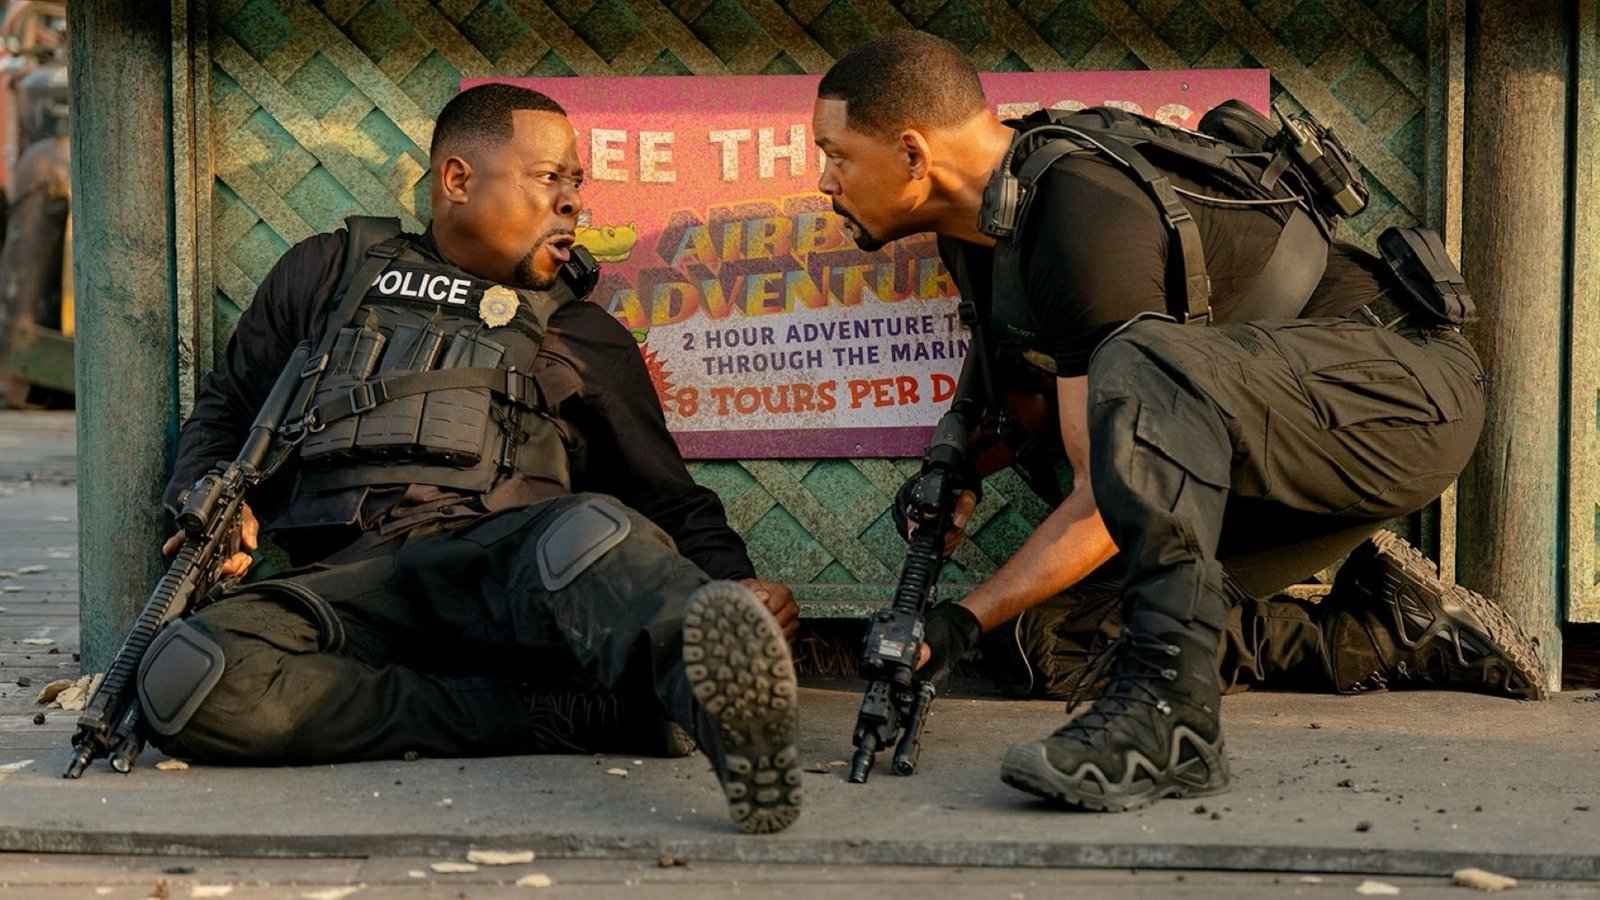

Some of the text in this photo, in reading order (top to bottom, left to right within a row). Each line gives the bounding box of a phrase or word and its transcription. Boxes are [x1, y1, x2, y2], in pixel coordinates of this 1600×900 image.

[573, 124, 827, 183] EE TH
[660, 196, 848, 267] AIRB
[371, 270, 471, 305] OLICE
[602, 258, 962, 329] ADVENTUR
[682, 332, 695, 351] 2
[705, 325, 774, 350] HOUR
[785, 314, 934, 344] ADVENTURE
[702, 338, 969, 376] THROUGH THE MARIN
[675, 372, 957, 417] 8 TOURS PER D
